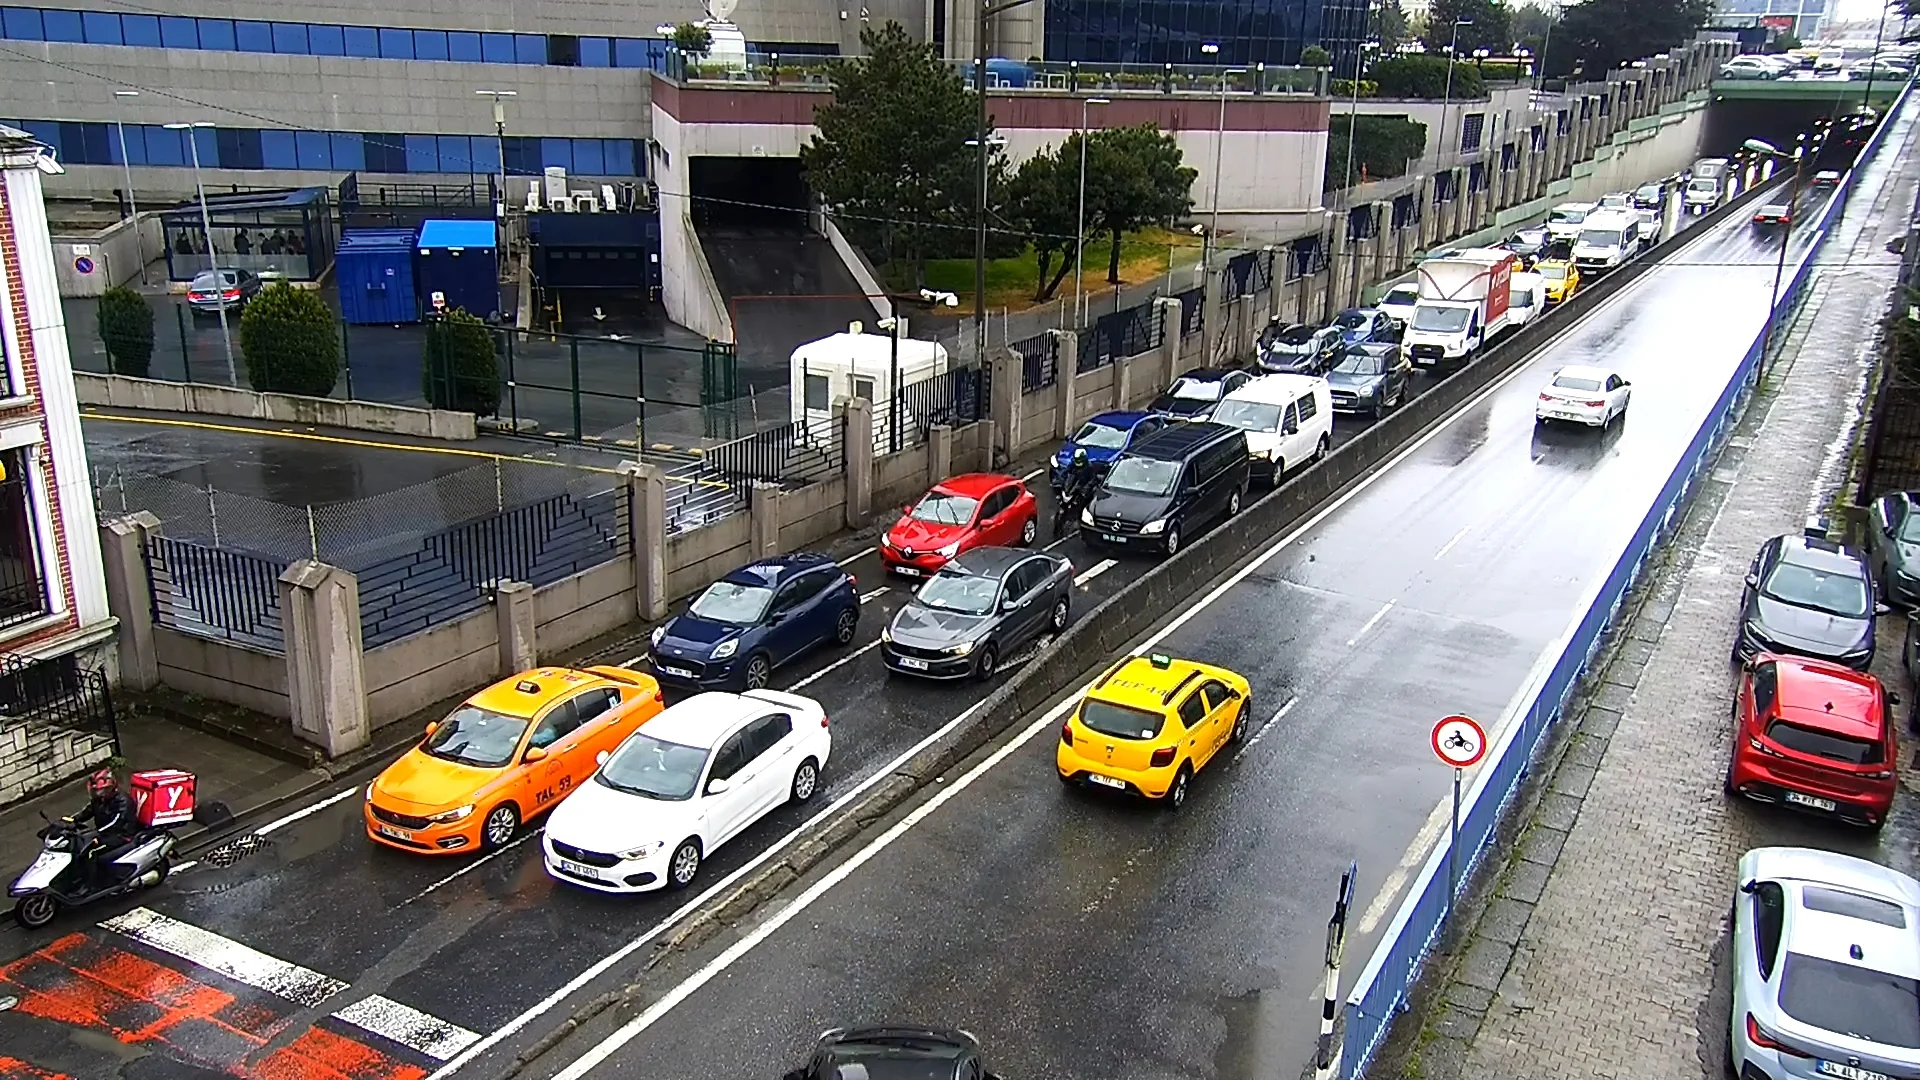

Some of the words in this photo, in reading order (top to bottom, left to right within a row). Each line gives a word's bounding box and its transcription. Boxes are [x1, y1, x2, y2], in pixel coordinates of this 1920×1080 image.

[535, 785, 555, 805] TAL
[559, 774, 572, 791] 59
[1824, 1062, 1837, 1073] 34
